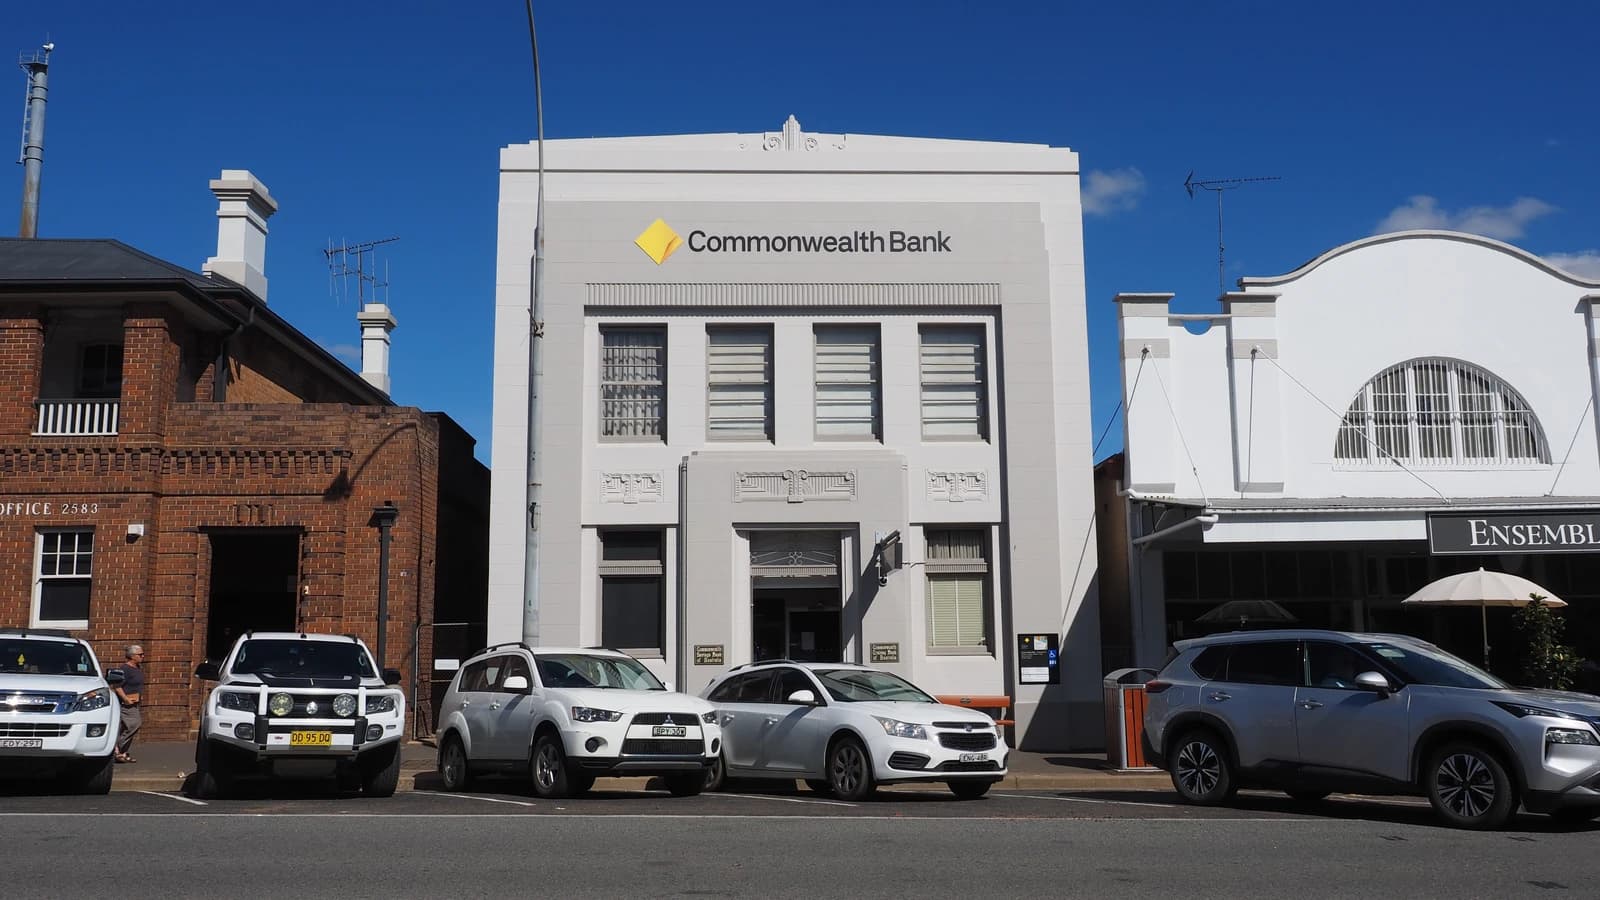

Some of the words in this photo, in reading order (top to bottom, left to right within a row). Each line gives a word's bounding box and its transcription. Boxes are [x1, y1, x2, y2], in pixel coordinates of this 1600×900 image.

[687, 229, 885, 253] Commonwealth
[889, 230, 952, 253] Bank
[61, 502, 99, 515] 2583
